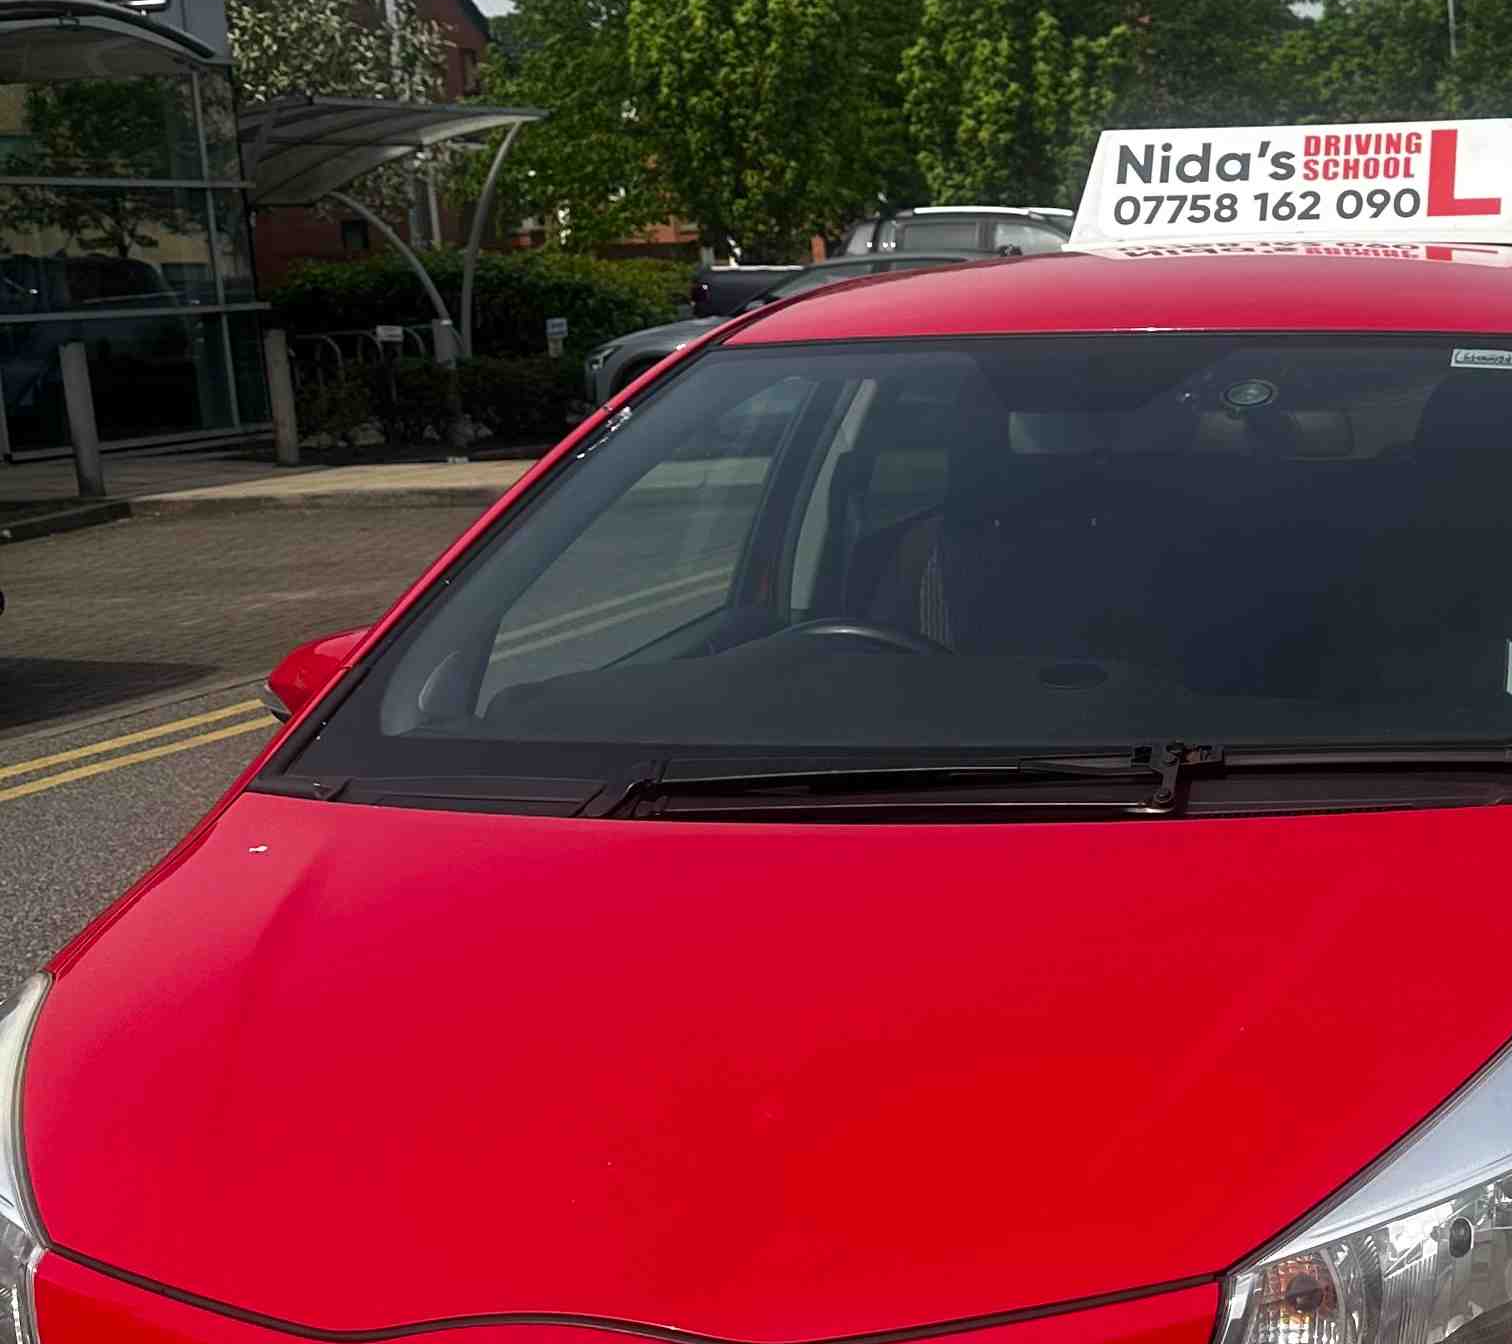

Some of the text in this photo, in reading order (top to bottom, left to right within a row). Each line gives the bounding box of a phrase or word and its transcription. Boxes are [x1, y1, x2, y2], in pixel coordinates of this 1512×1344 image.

[1115, 140, 1297, 185] Nida's
[1303, 132, 1422, 157] DRIVING
[1303, 156, 1415, 181] SCHOOL
[1427, 129, 1502, 217] L
[1114, 188, 1421, 226] 07758 162 090
